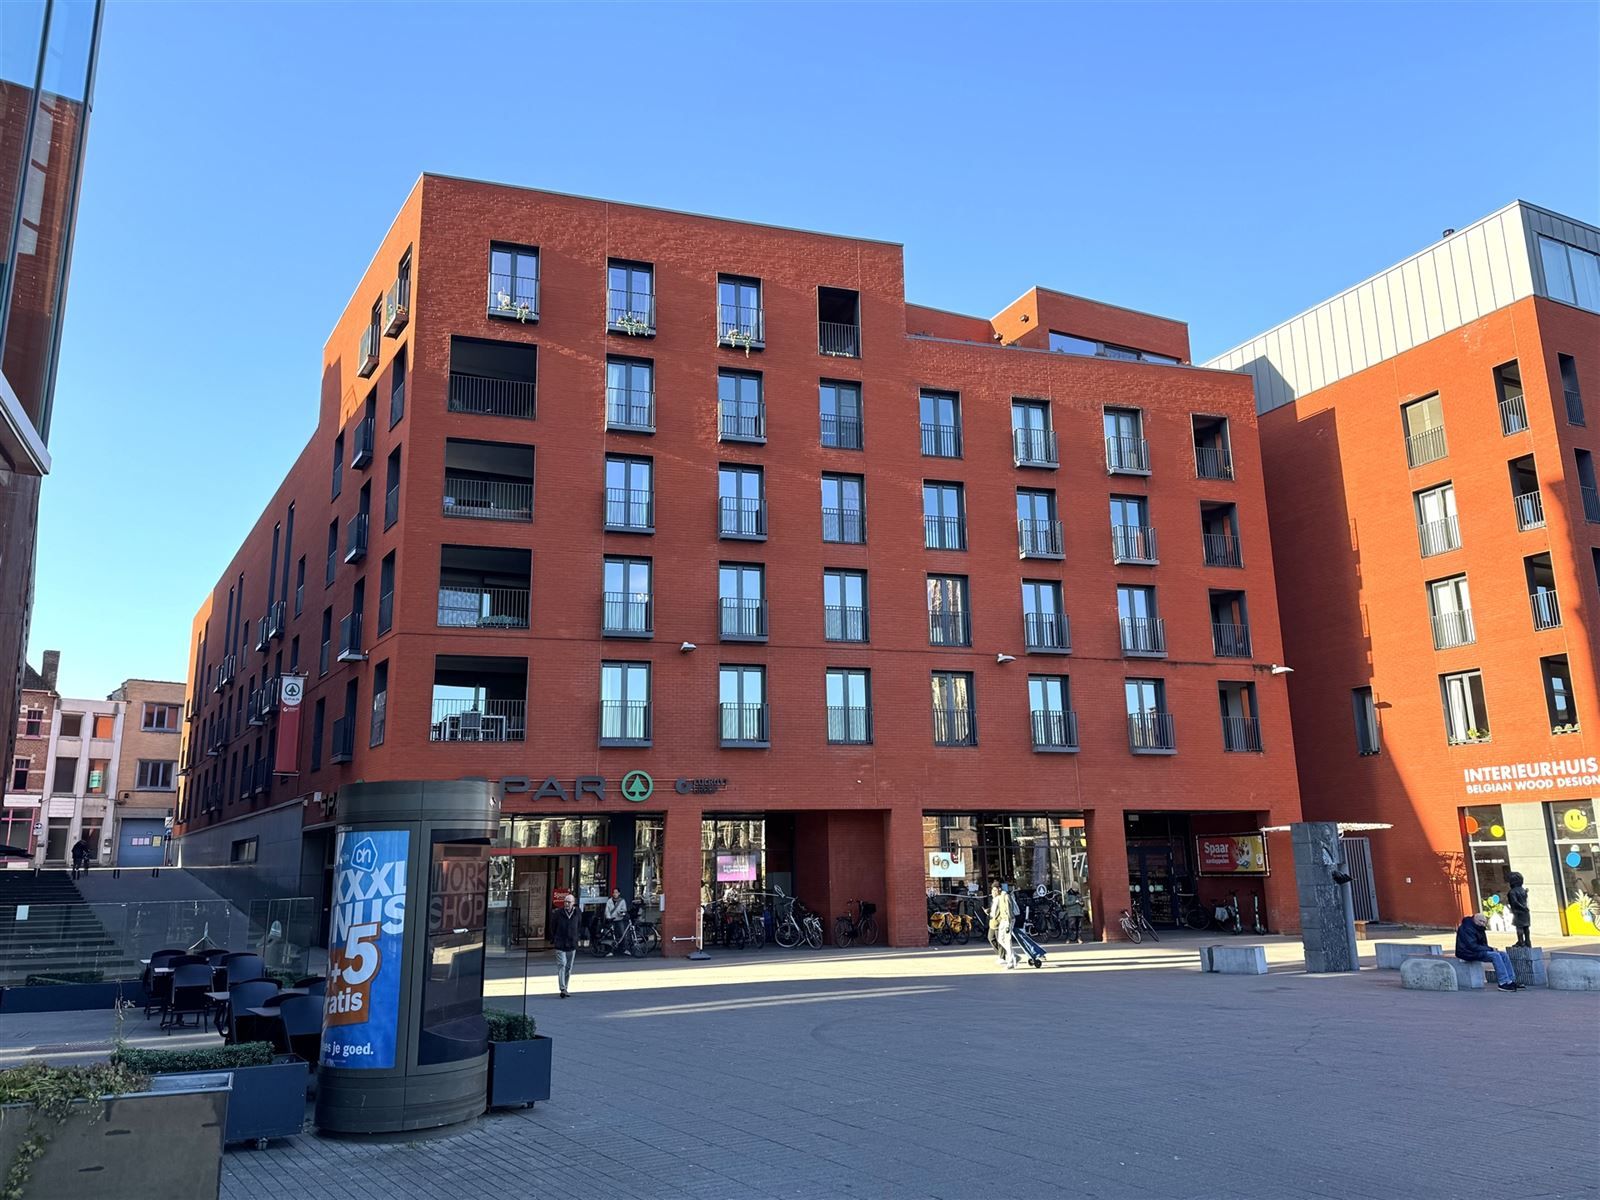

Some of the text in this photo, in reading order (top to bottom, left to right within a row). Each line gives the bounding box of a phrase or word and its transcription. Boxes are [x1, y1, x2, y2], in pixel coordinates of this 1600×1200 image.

[1463, 757, 1599, 783] INTERIEURHUIS
[463, 775, 608, 801] PAR
[1466, 775, 1600, 794] BELGIAN WOOD DESIGN
[1204, 842, 1229, 856] Spaar
[432, 862, 487, 893] WORK
[429, 894, 485, 930] SHOP
[332, 1041, 341, 1056] je
[342, 1042, 374, 1057] goed.
